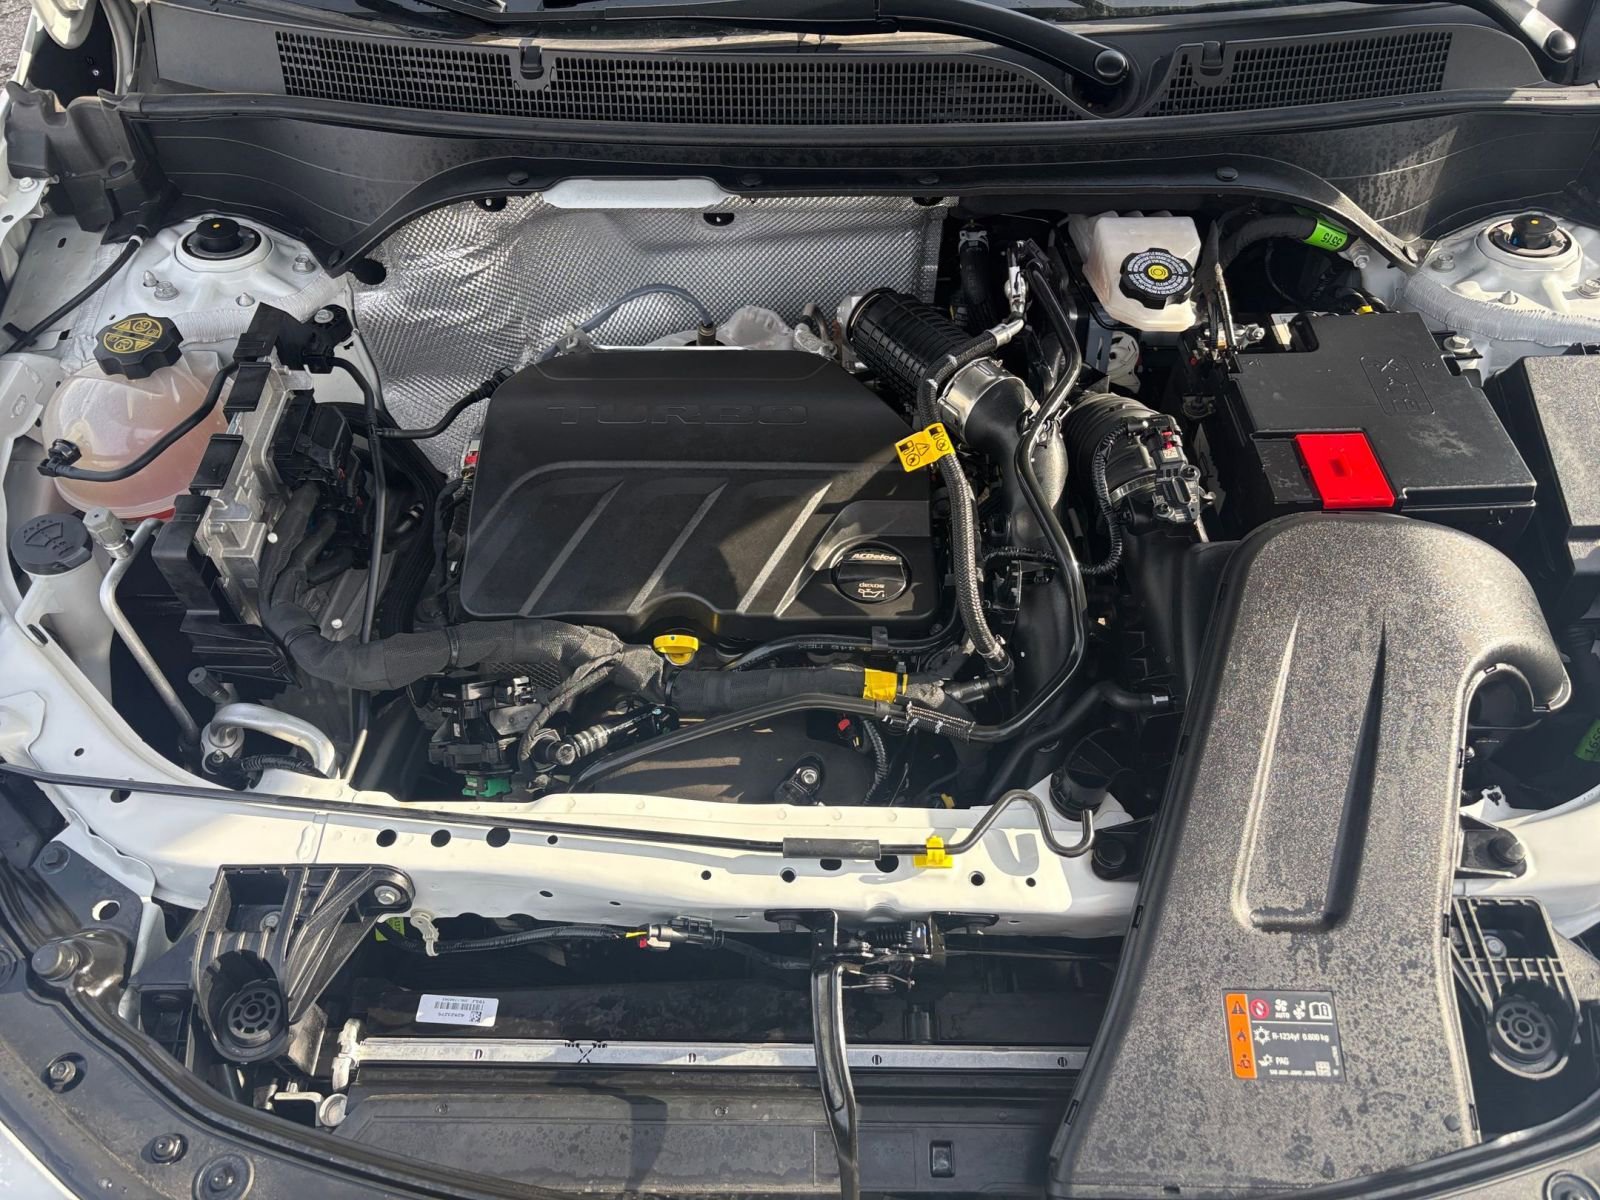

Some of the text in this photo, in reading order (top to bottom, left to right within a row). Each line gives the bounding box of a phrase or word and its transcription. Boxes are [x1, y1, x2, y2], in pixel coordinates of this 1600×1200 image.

[1320, 232, 1343, 247] 5515
[547, 404, 809, 426] TURBO
[851, 553, 897, 561] ACDelco
[1271, 1032, 1300, 1042] R-1234yf
[1320, 1033, 1330, 1043] kg
[1275, 1057, 1290, 1066] PAG
